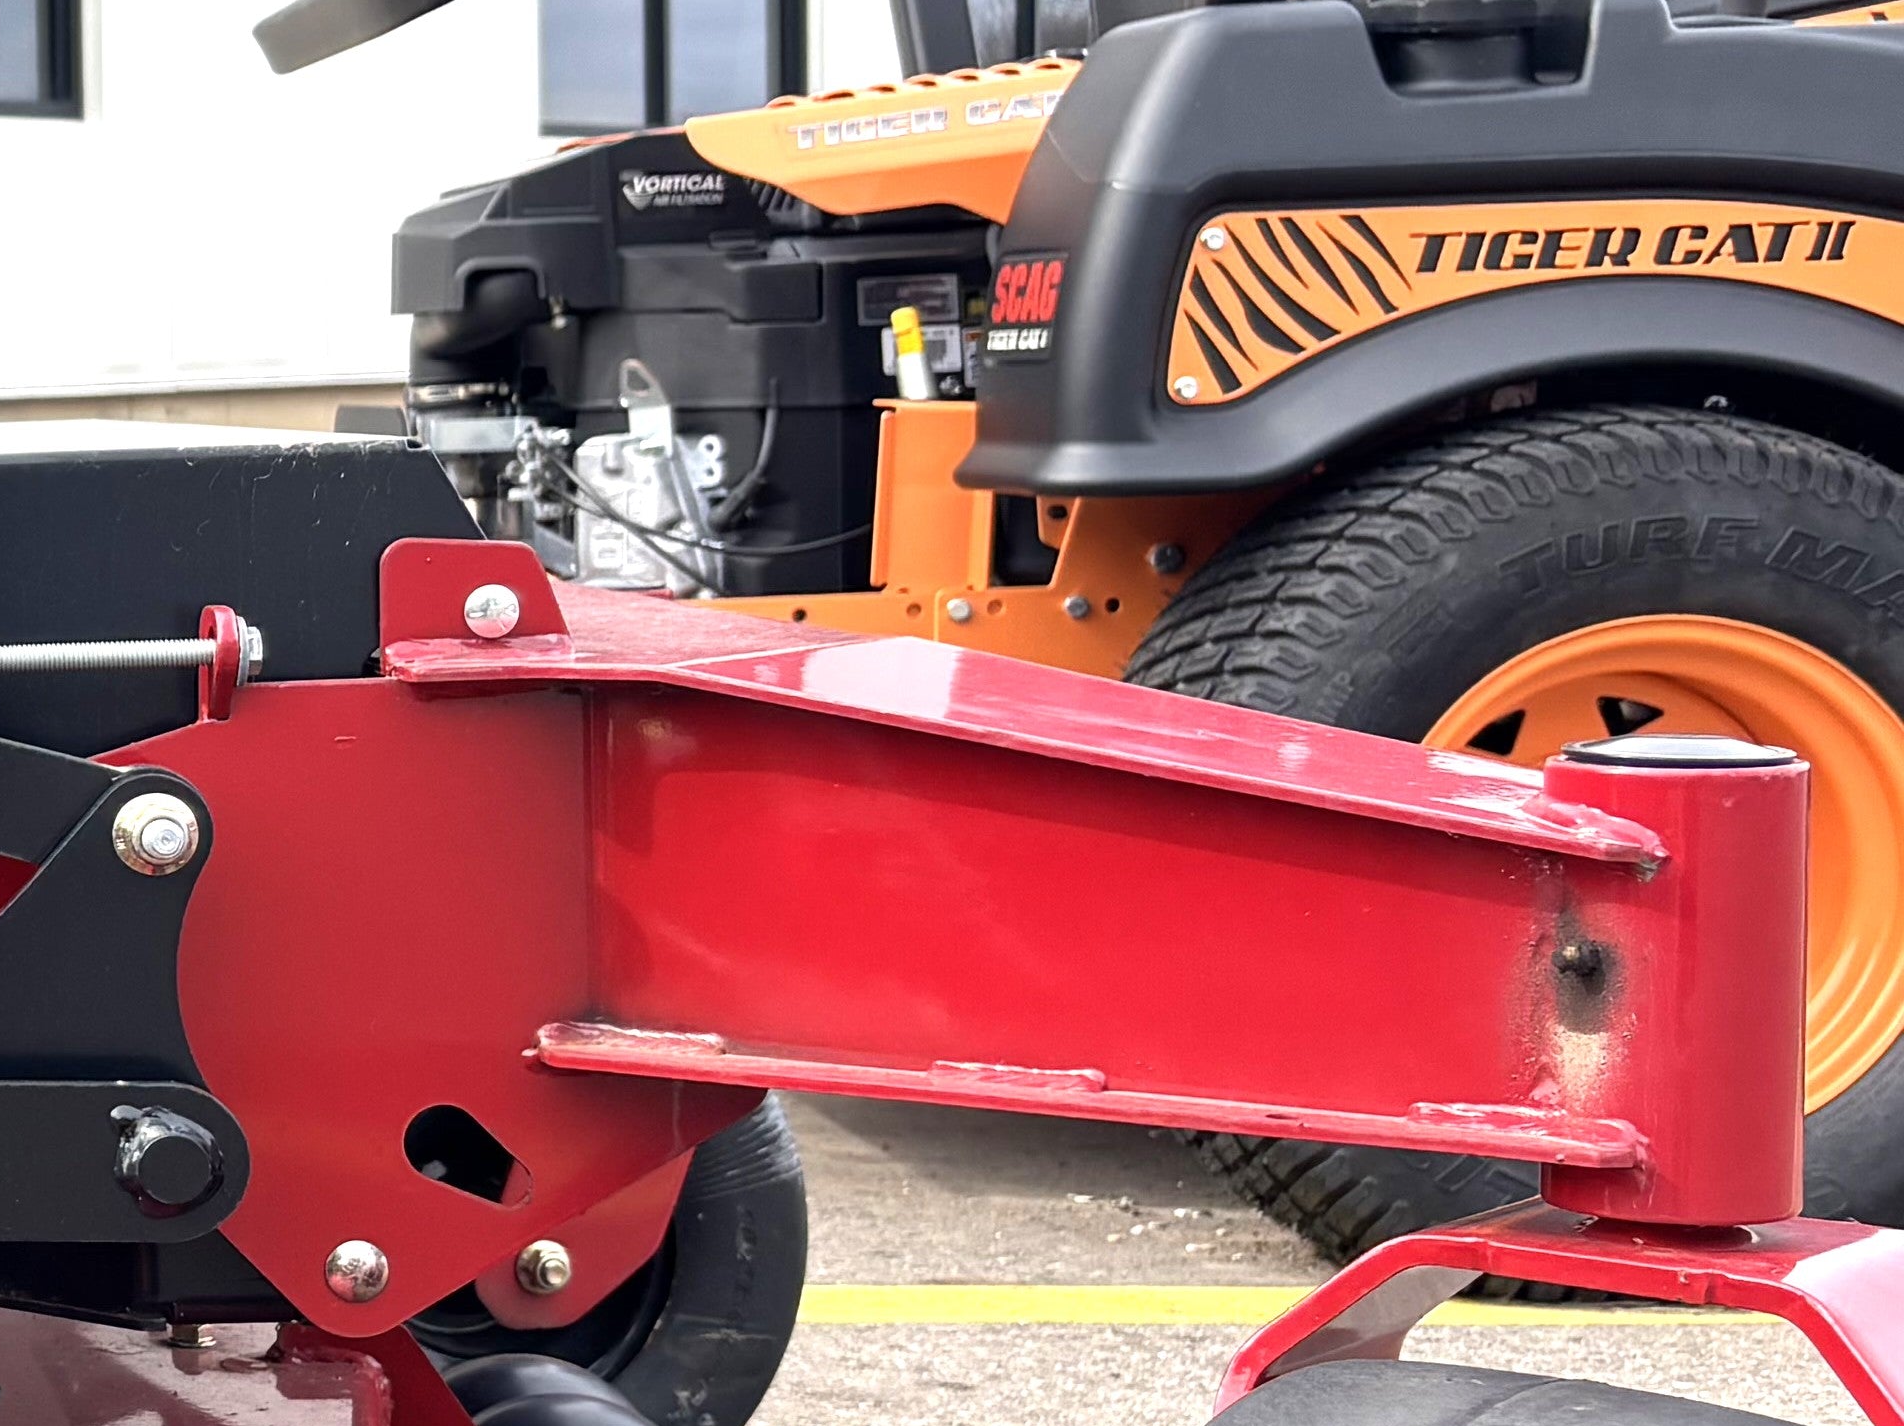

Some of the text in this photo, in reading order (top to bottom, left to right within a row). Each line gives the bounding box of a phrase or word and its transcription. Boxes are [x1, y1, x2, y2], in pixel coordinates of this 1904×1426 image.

[788, 109, 948, 151] TIGER
[632, 174, 725, 194] VORTICAL
[1409, 221, 1857, 274] TIGER CAT II
[990, 260, 1064, 324] SCAG
[1498, 513, 1760, 599] TURF
